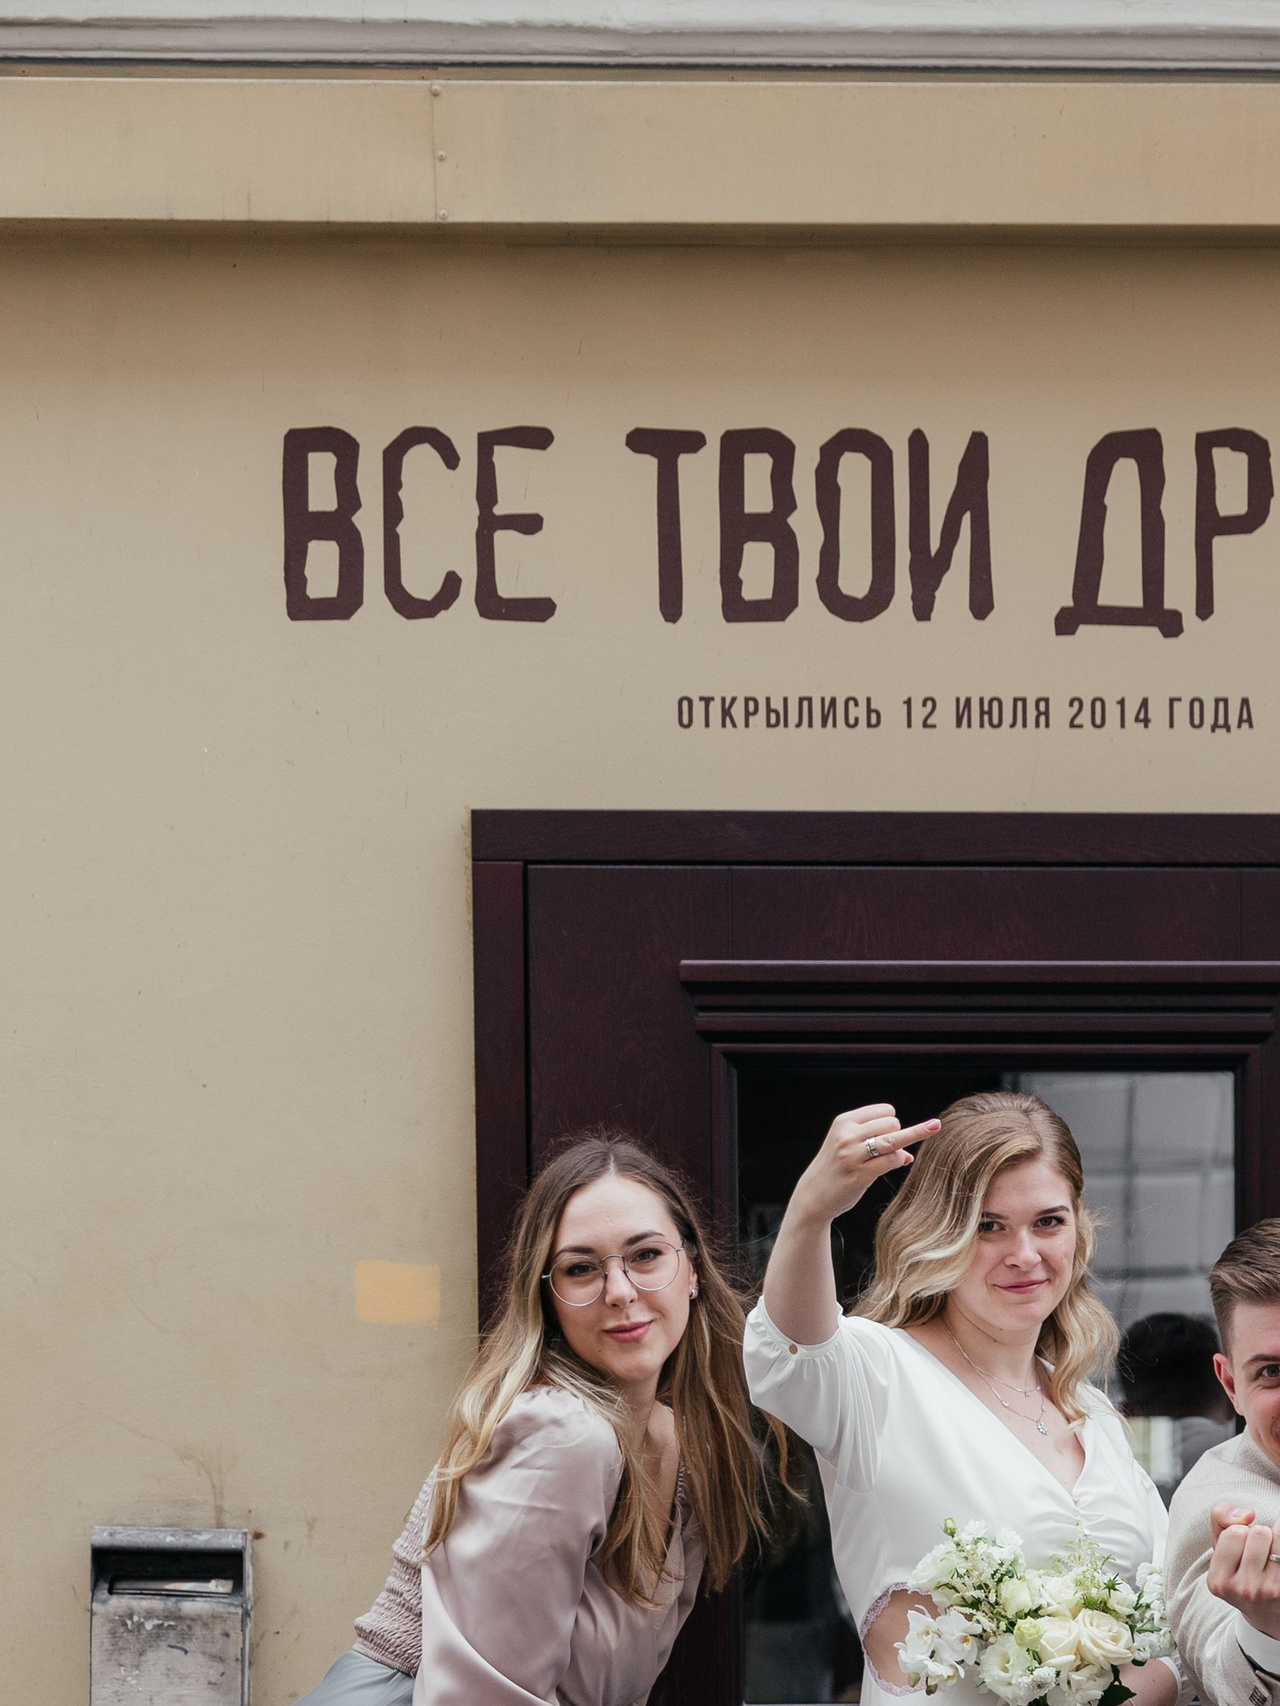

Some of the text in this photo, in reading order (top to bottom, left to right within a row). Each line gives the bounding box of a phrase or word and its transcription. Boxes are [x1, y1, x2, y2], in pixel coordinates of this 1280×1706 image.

[282, 425, 558, 623] ВСЕ
[624, 426, 995, 625] ТВОИ
[677, 695, 1254, 734] ОТКРЫЛИСЬ 12 ИЮЛЯ 2014 ГОДА
